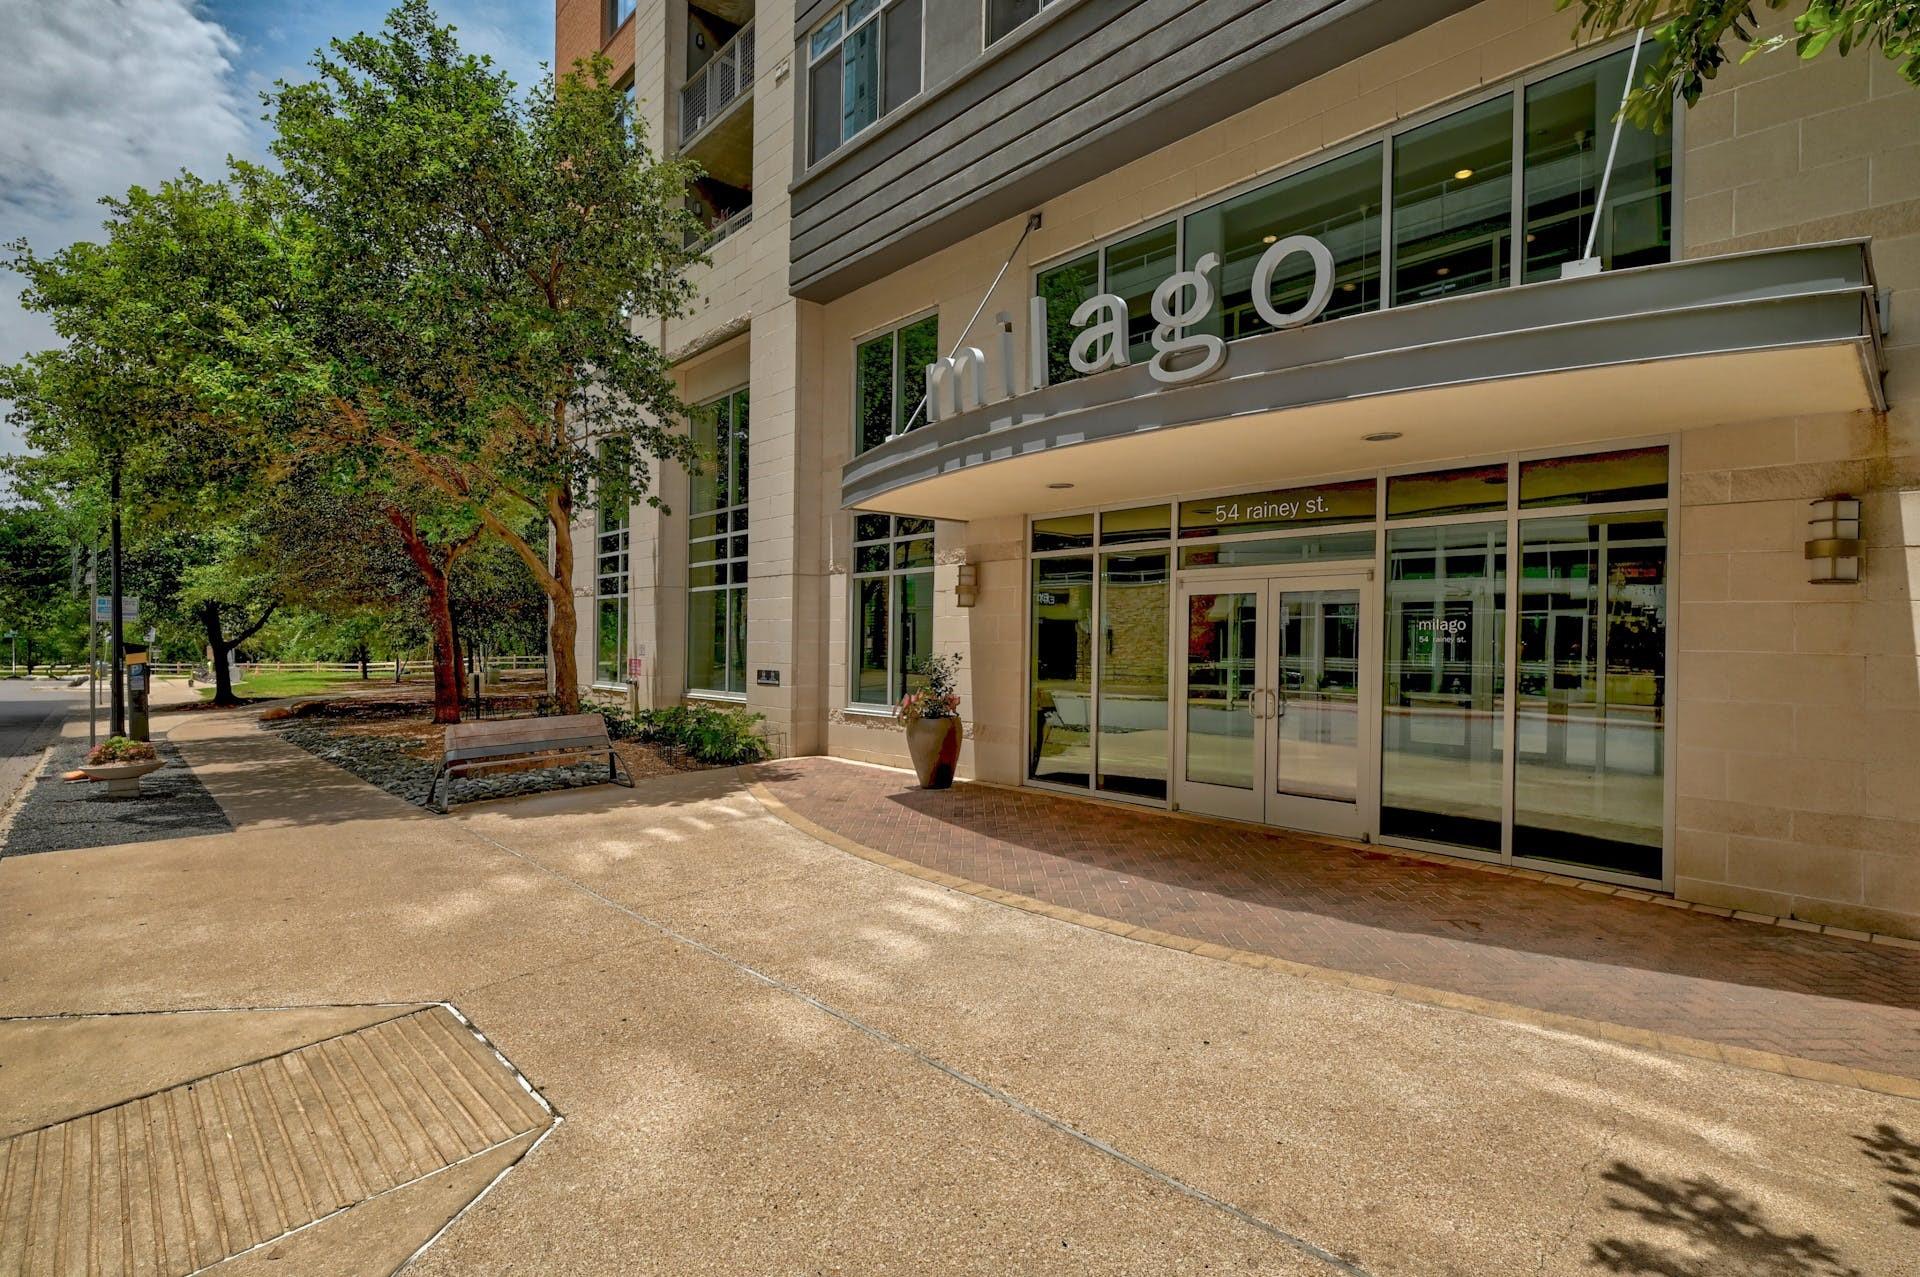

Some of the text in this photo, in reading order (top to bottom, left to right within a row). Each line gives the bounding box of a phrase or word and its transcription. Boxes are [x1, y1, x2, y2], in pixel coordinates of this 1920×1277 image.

[925, 235, 1335, 422] milago
[1215, 495, 1329, 523] 54 rainey st.
[1418, 618, 1467, 634] milago
[1418, 635, 1429, 643] 54
